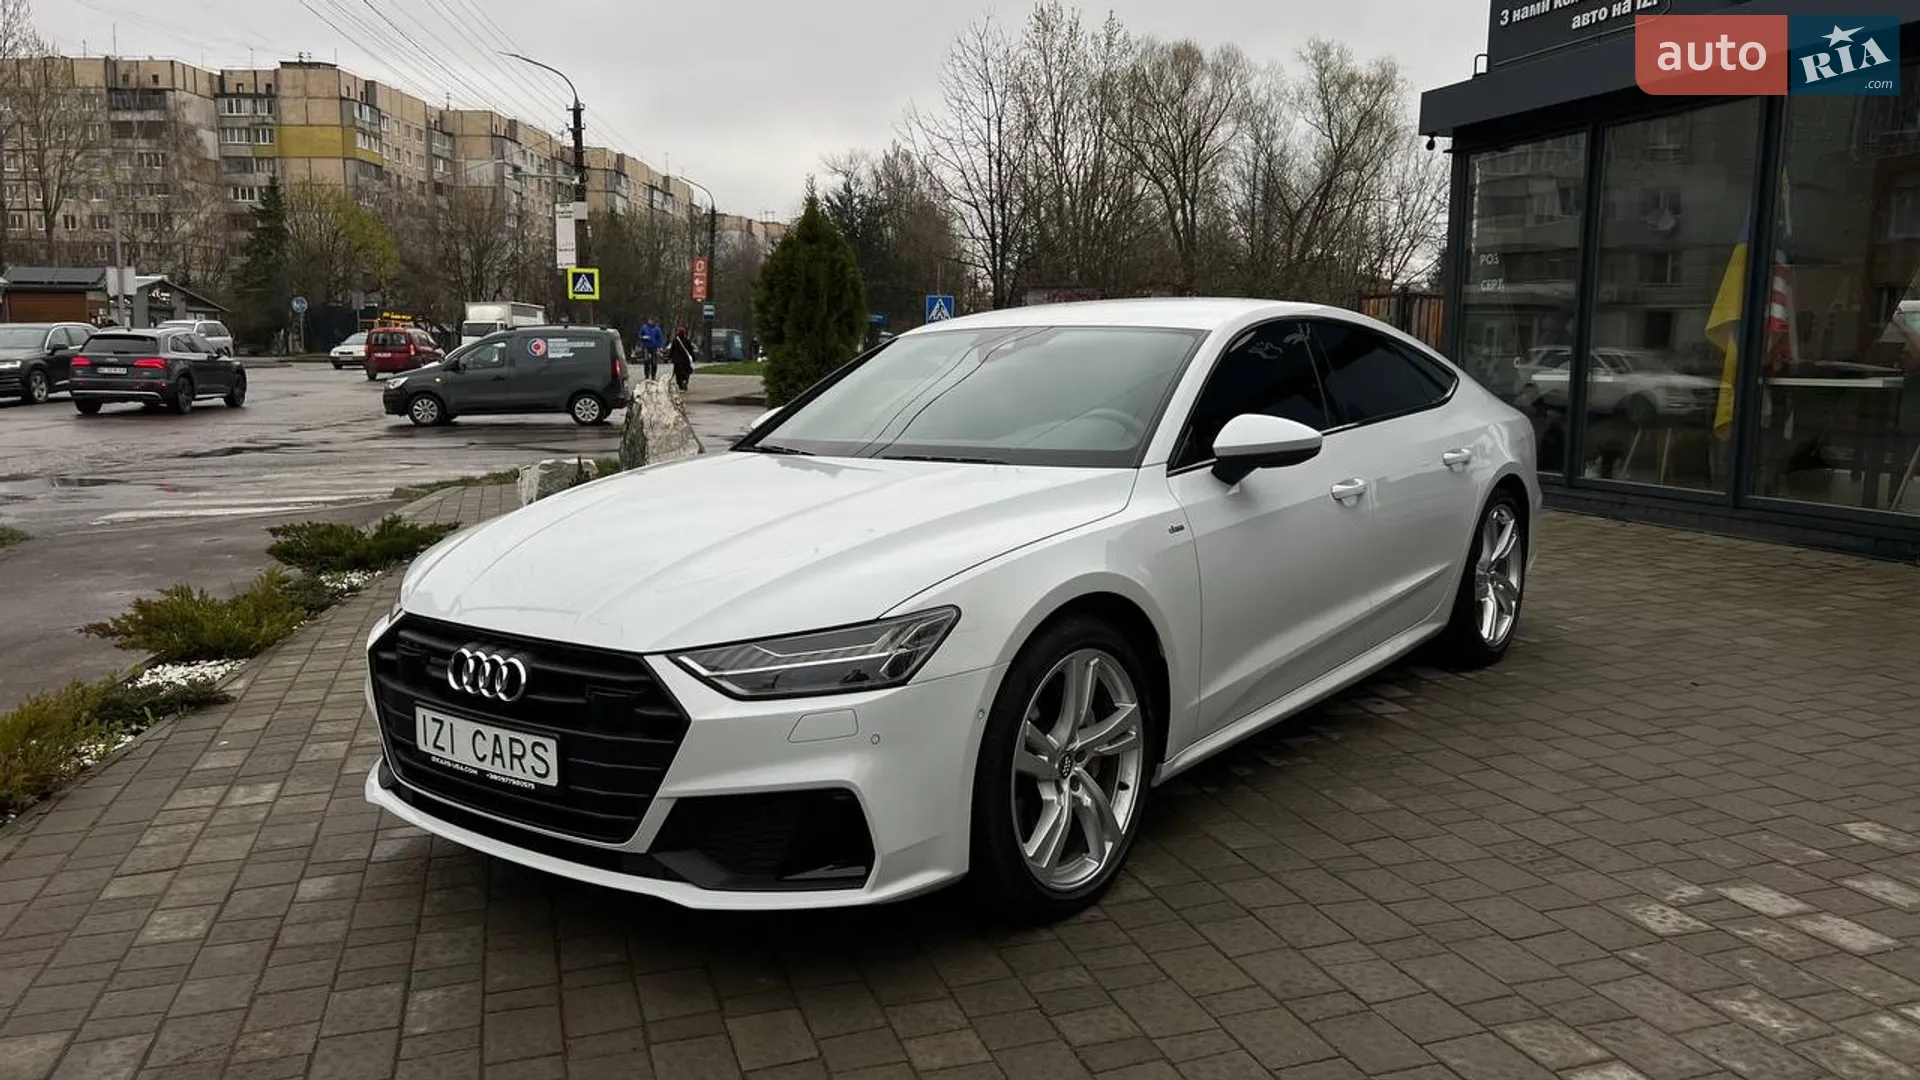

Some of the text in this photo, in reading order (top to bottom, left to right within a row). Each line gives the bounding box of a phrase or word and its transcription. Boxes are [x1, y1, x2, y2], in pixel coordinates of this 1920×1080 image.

[1500, 9, 1510, 26] З
[1512, 0, 1550, 22] нами
[1571, 7, 1609, 29] авто
[1612, 0, 1632, 17] на
[422, 714, 550, 779] IZI CARS
